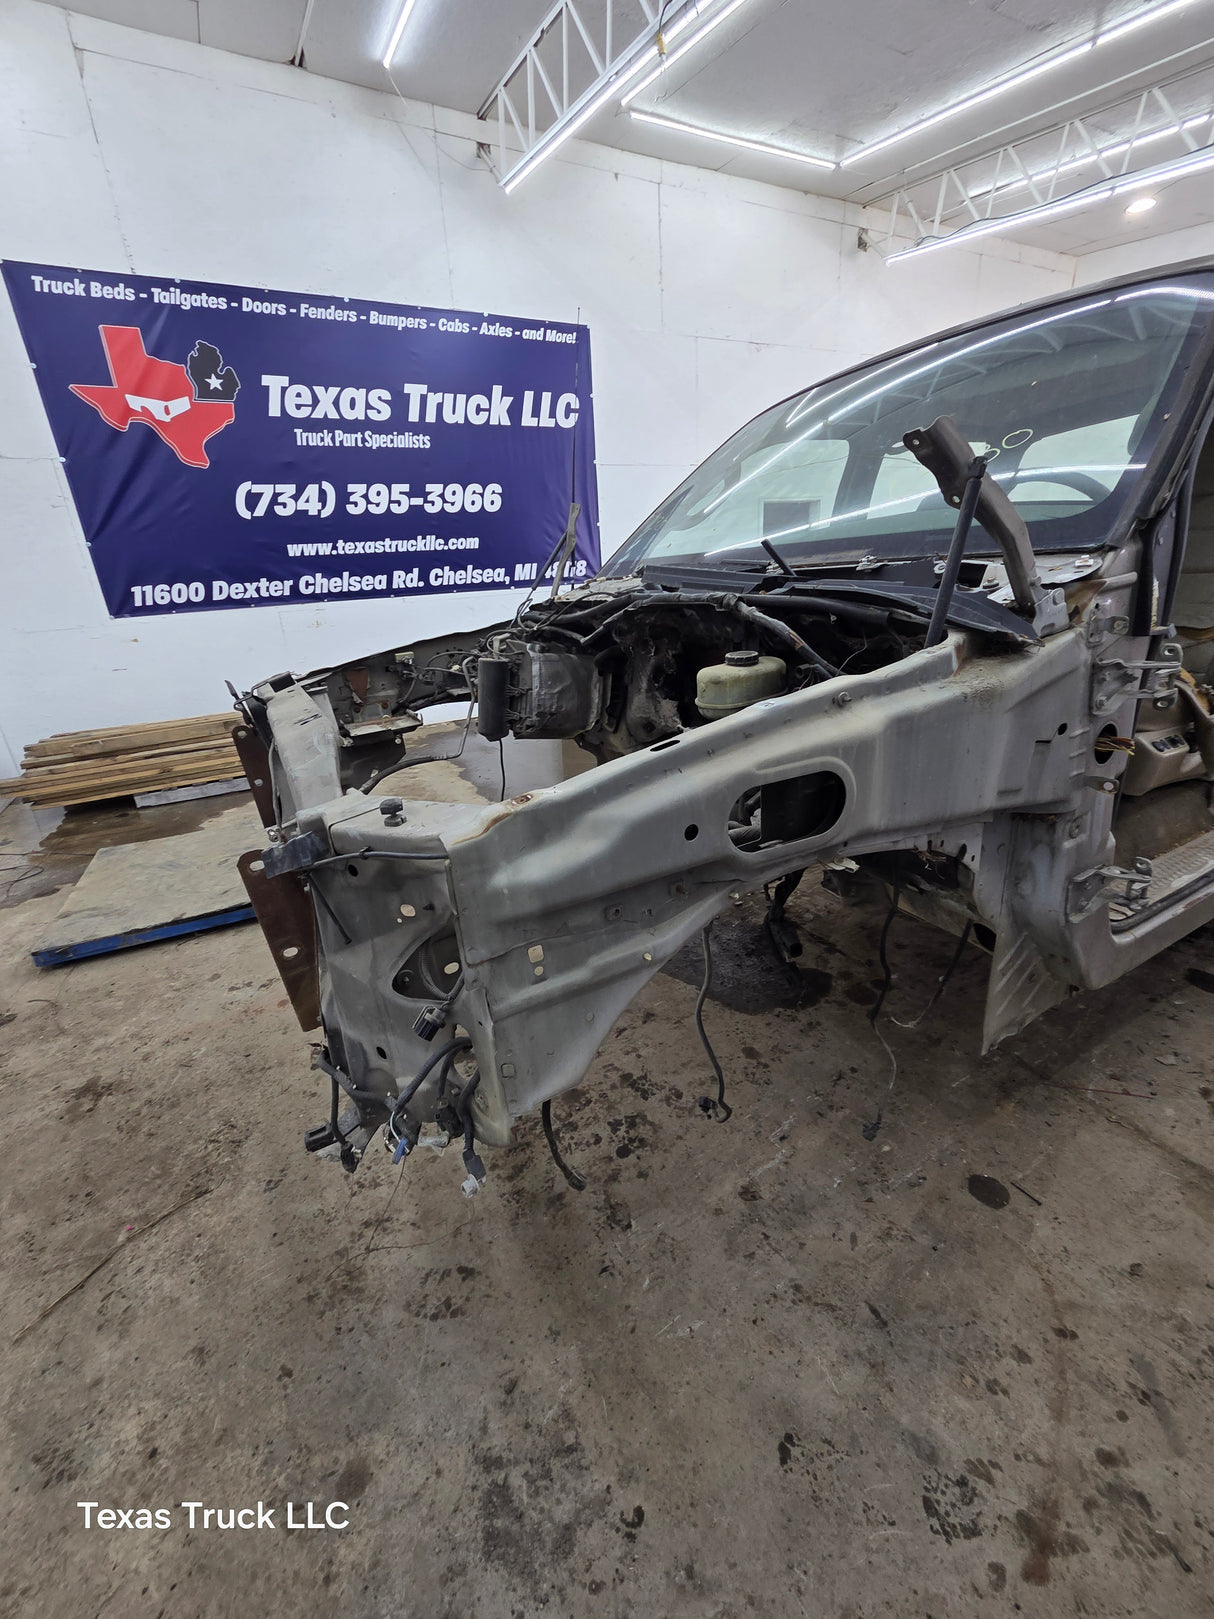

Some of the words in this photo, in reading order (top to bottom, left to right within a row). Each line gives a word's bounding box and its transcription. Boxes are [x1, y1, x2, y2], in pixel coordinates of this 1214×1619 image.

[30, 275, 87, 297] Truck
[90, 281, 136, 301] Beds
[150, 287, 228, 310] Tailgates
[241, 297, 287, 316] Doors
[299, 303, 358, 322] Fenders
[369, 310, 428, 330] Bumpers
[438, 317, 471, 334] Cabs
[479, 321, 513, 338] Axles
[522, 327, 544, 341] and
[545, 329, 577, 344] More!
[261, 374, 392, 421] Texas
[403, 383, 515, 426] Truck
[520, 390, 580, 429] LLC
[293, 428, 334, 447] Truck
[334, 429, 364, 448] Part
[364, 430, 431, 450] Specialists
[235, 480, 336, 520] (734)
[345, 483, 503, 515] 395-3966
[286, 535, 480, 557] www.texastruckllc.com
[130, 582, 206, 607] 11600
[212, 577, 294, 601] Dexter
[298, 572, 388, 595] Chelsea
[392, 567, 425, 589] Rd.
[429, 564, 511, 587] Chelsea,
[514, 562, 538, 581] MI
